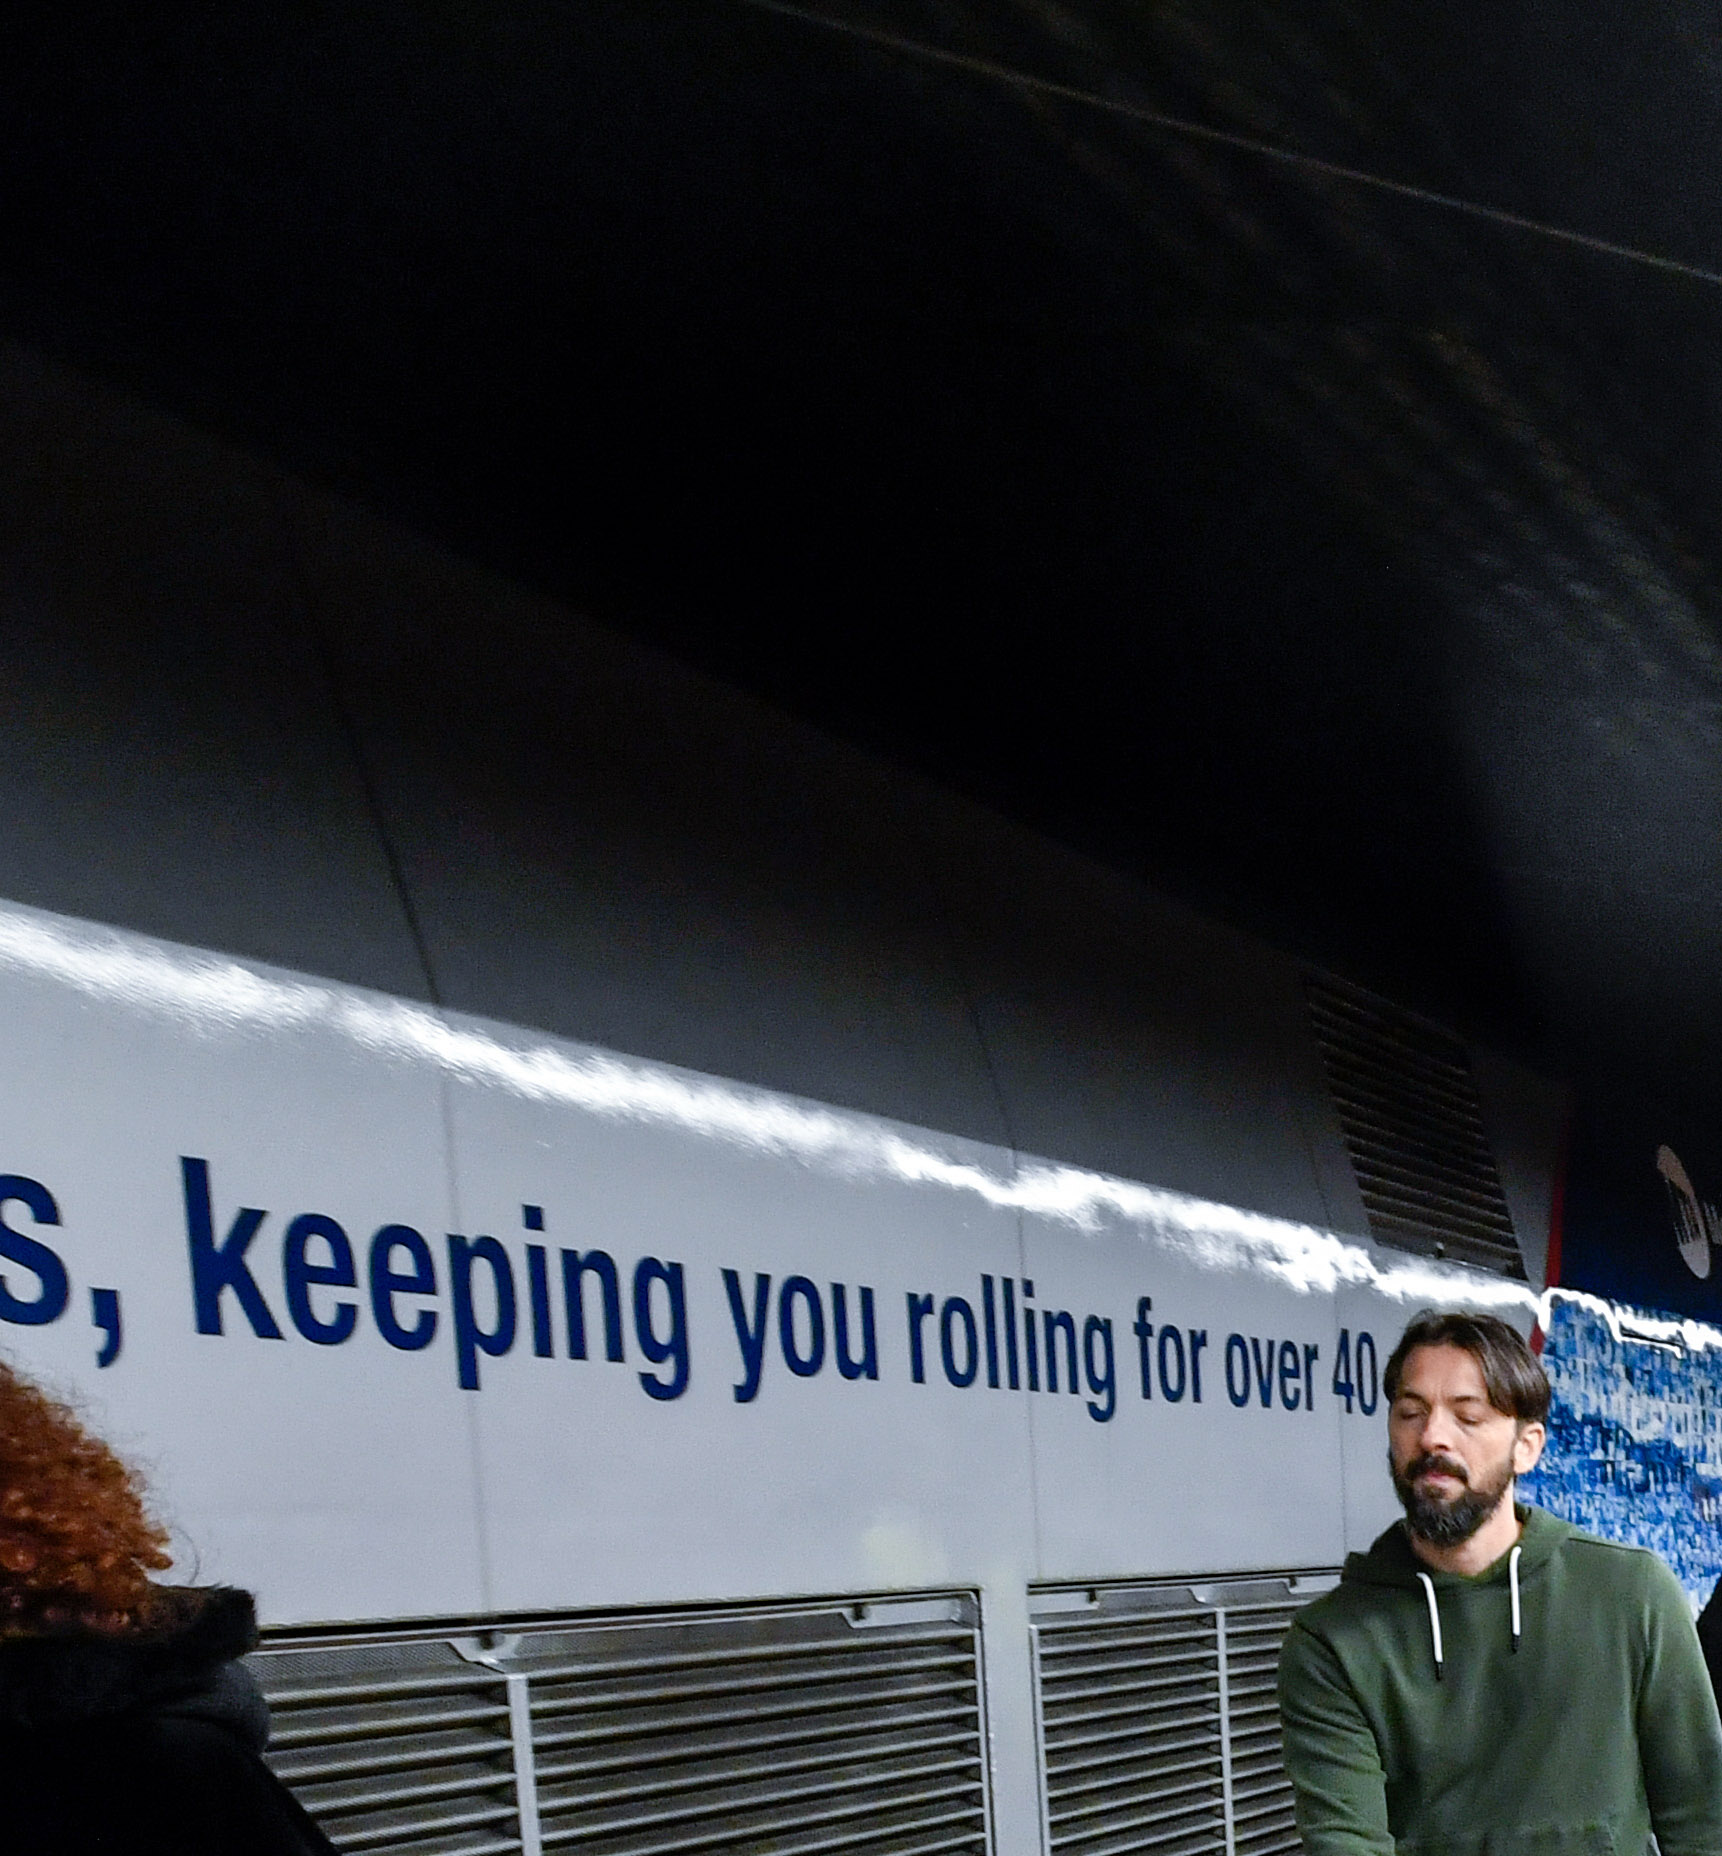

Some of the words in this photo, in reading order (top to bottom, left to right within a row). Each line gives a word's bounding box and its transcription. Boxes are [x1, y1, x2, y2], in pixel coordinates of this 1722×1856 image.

[179, 1155, 693, 1402] keeping
[720, 1267, 881, 1403] you
[904, 1272, 1118, 1423] rolling
[1132, 1296, 1208, 1403] for
[1224, 1330, 1319, 1414] over
[1330, 1327, 1379, 1417] 40
